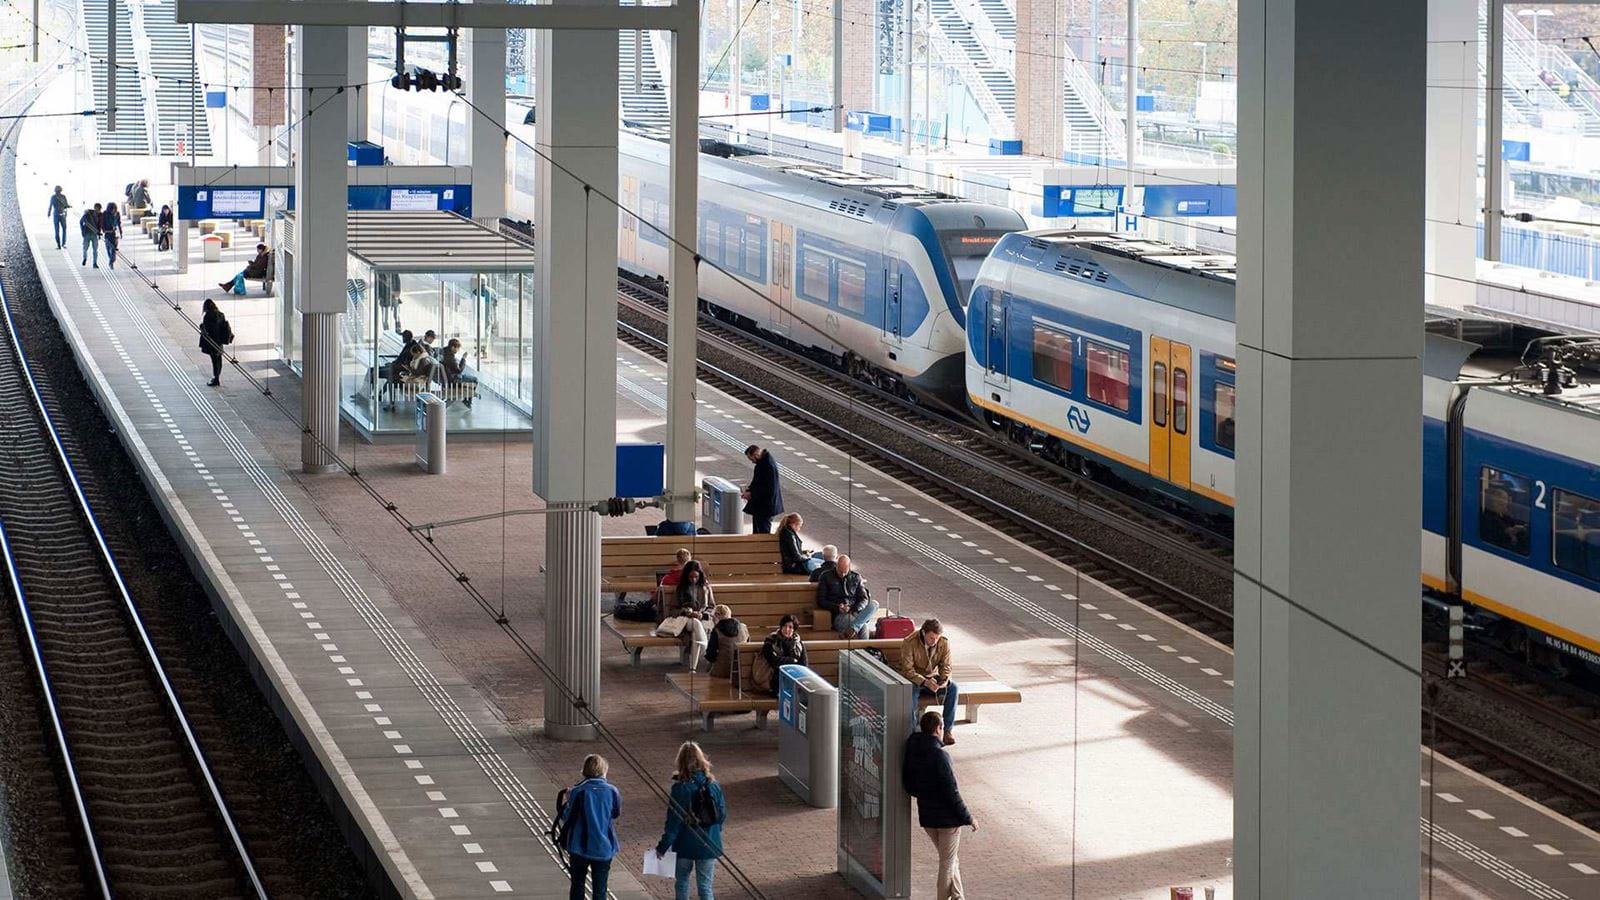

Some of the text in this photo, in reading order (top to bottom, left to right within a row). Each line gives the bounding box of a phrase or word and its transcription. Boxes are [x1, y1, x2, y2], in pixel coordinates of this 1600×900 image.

[1126, 216, 1137, 231] H
[1077, 336, 1082, 357] 1
[1535, 480, 1546, 509] 2
